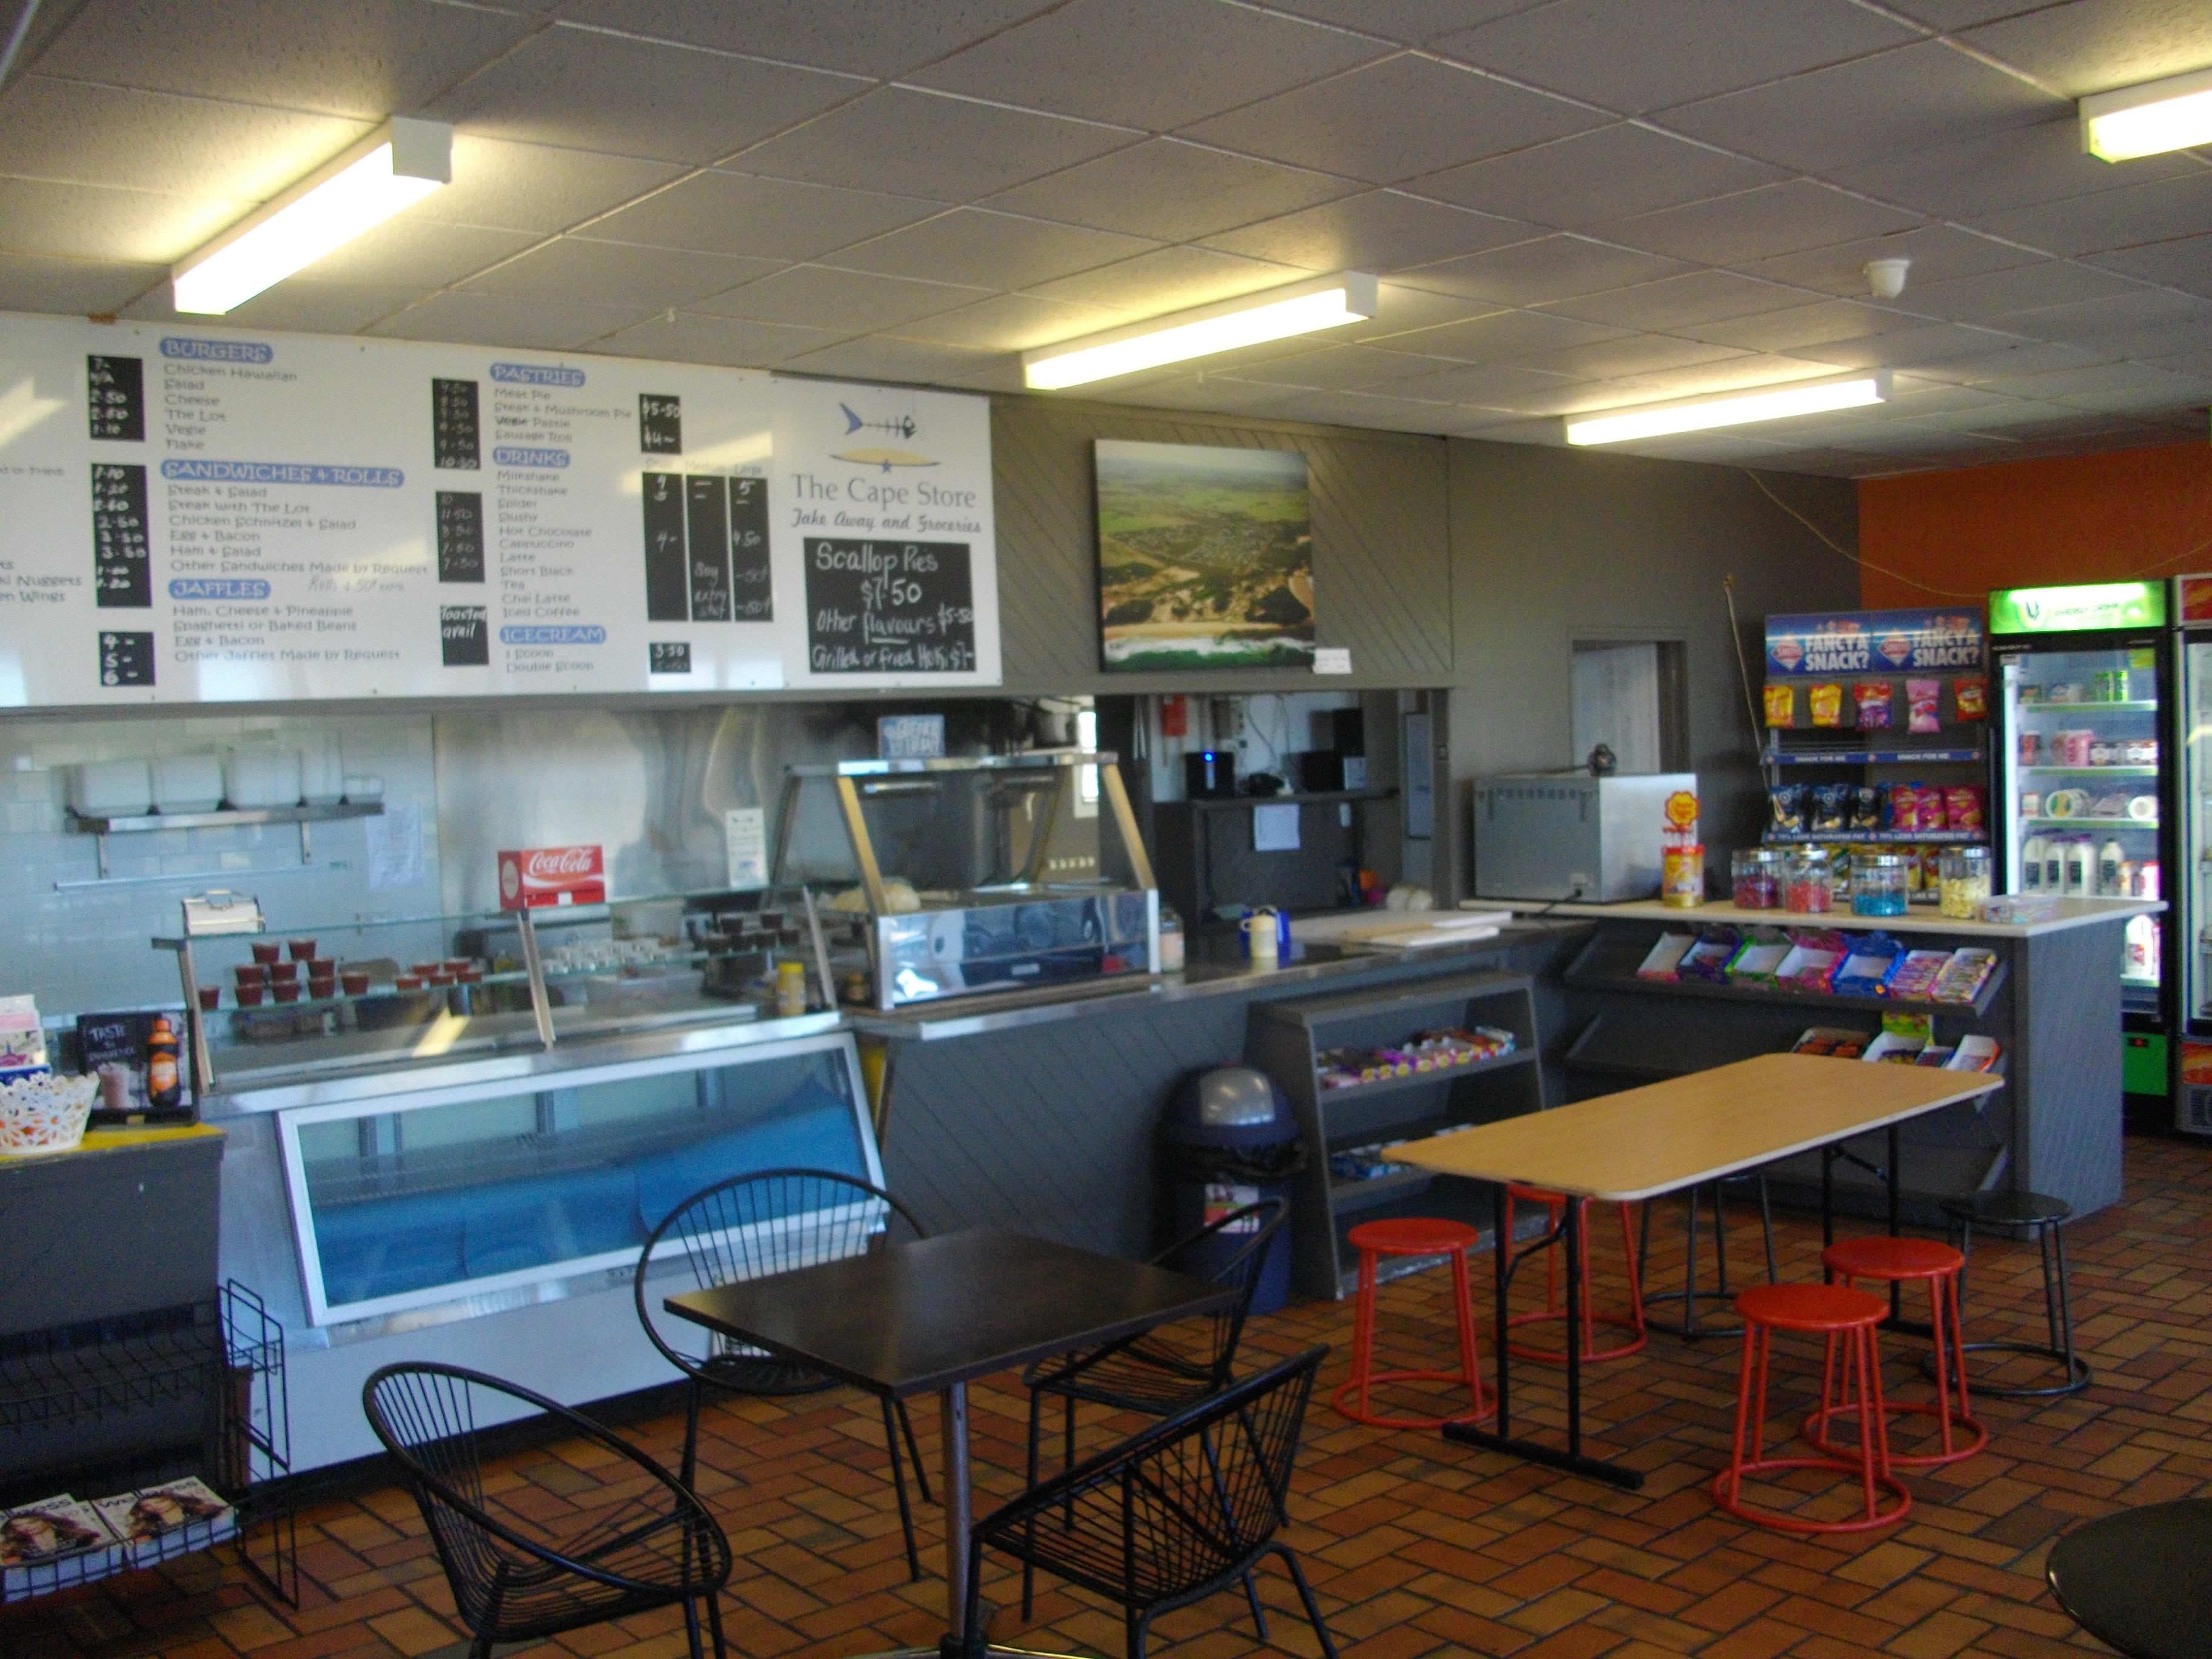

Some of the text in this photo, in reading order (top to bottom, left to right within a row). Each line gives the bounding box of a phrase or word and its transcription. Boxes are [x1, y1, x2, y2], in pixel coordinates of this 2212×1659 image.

[166, 339, 266, 361] BURGERS
[163, 364, 225, 377] Chicken
[494, 366, 583, 385] PASTRIES
[164, 378, 204, 390] Salad
[165, 393, 220, 406] Cheese
[494, 388, 551, 400] Meat Pie
[166, 409, 226, 422] The Lot
[494, 402, 529, 413] Steak
[545, 404, 610, 418] Mushroom
[613, 408, 632, 419] Pie
[166, 424, 206, 437] Vegie
[495, 429, 572, 443] Sausage Roll
[166, 438, 204, 451] Flake
[497, 448, 566, 466] DRINKS
[166, 461, 312, 483] SANDWICHES
[333, 468, 400, 486] ROLLS
[497, 471, 560, 483] Milkshake
[168, 484, 210, 497] Steak
[228, 486, 267, 498] Salad
[497, 484, 568, 497] Thickshake
[791, 473, 839, 501] The
[847, 477, 909, 511] Cape
[917, 481, 977, 509] Store
[169, 500, 310, 515] Steak with The Lot
[498, 498, 538, 510] Spider
[169, 515, 230, 527] Chicken
[235, 516, 302, 529] Schnitzel
[318, 518, 357, 531] Salad
[498, 512, 538, 524] Slushy
[790, 508, 981, 534] Take Away and Groceries
[169, 529, 197, 542] Egg
[215, 529, 261, 542] Bacon
[499, 526, 592, 538] Hot Chocolate
[499, 538, 574, 550] Cappuccino
[170, 545, 204, 557] Ham
[222, 545, 261, 558] Salad
[500, 552, 536, 563] Latte
[170, 560, 216, 572] Other
[221, 561, 306, 574] Sandwiches
[309, 561, 348, 574] Made
[373, 563, 429, 575] Request
[500, 566, 574, 577] Short Black
[815, 541, 938, 589] Scallop Pies
[173, 580, 266, 597] JAFFLES
[501, 580, 525, 591] Tea
[502, 592, 571, 605] Chai Latte
[216, 606, 269, 617] Cheese
[286, 605, 354, 618] Pineapple
[503, 606, 580, 618] Iced Coffee
[173, 620, 357, 633] Spaghetti or Baked Beans
[174, 634, 201, 648] Egg
[219, 634, 265, 646] Bacon
[504, 627, 604, 643] ICECREAM
[174, 649, 218, 663] Other
[227, 649, 275, 661] Jaffles
[280, 649, 320, 661] Made
[344, 648, 401, 662] Request
[515, 648, 554, 660] Scoop
[1912, 645, 1979, 668] SNACK?
[506, 660, 594, 674] Double Scoop
[1805, 651, 1869, 672] SNACK?
